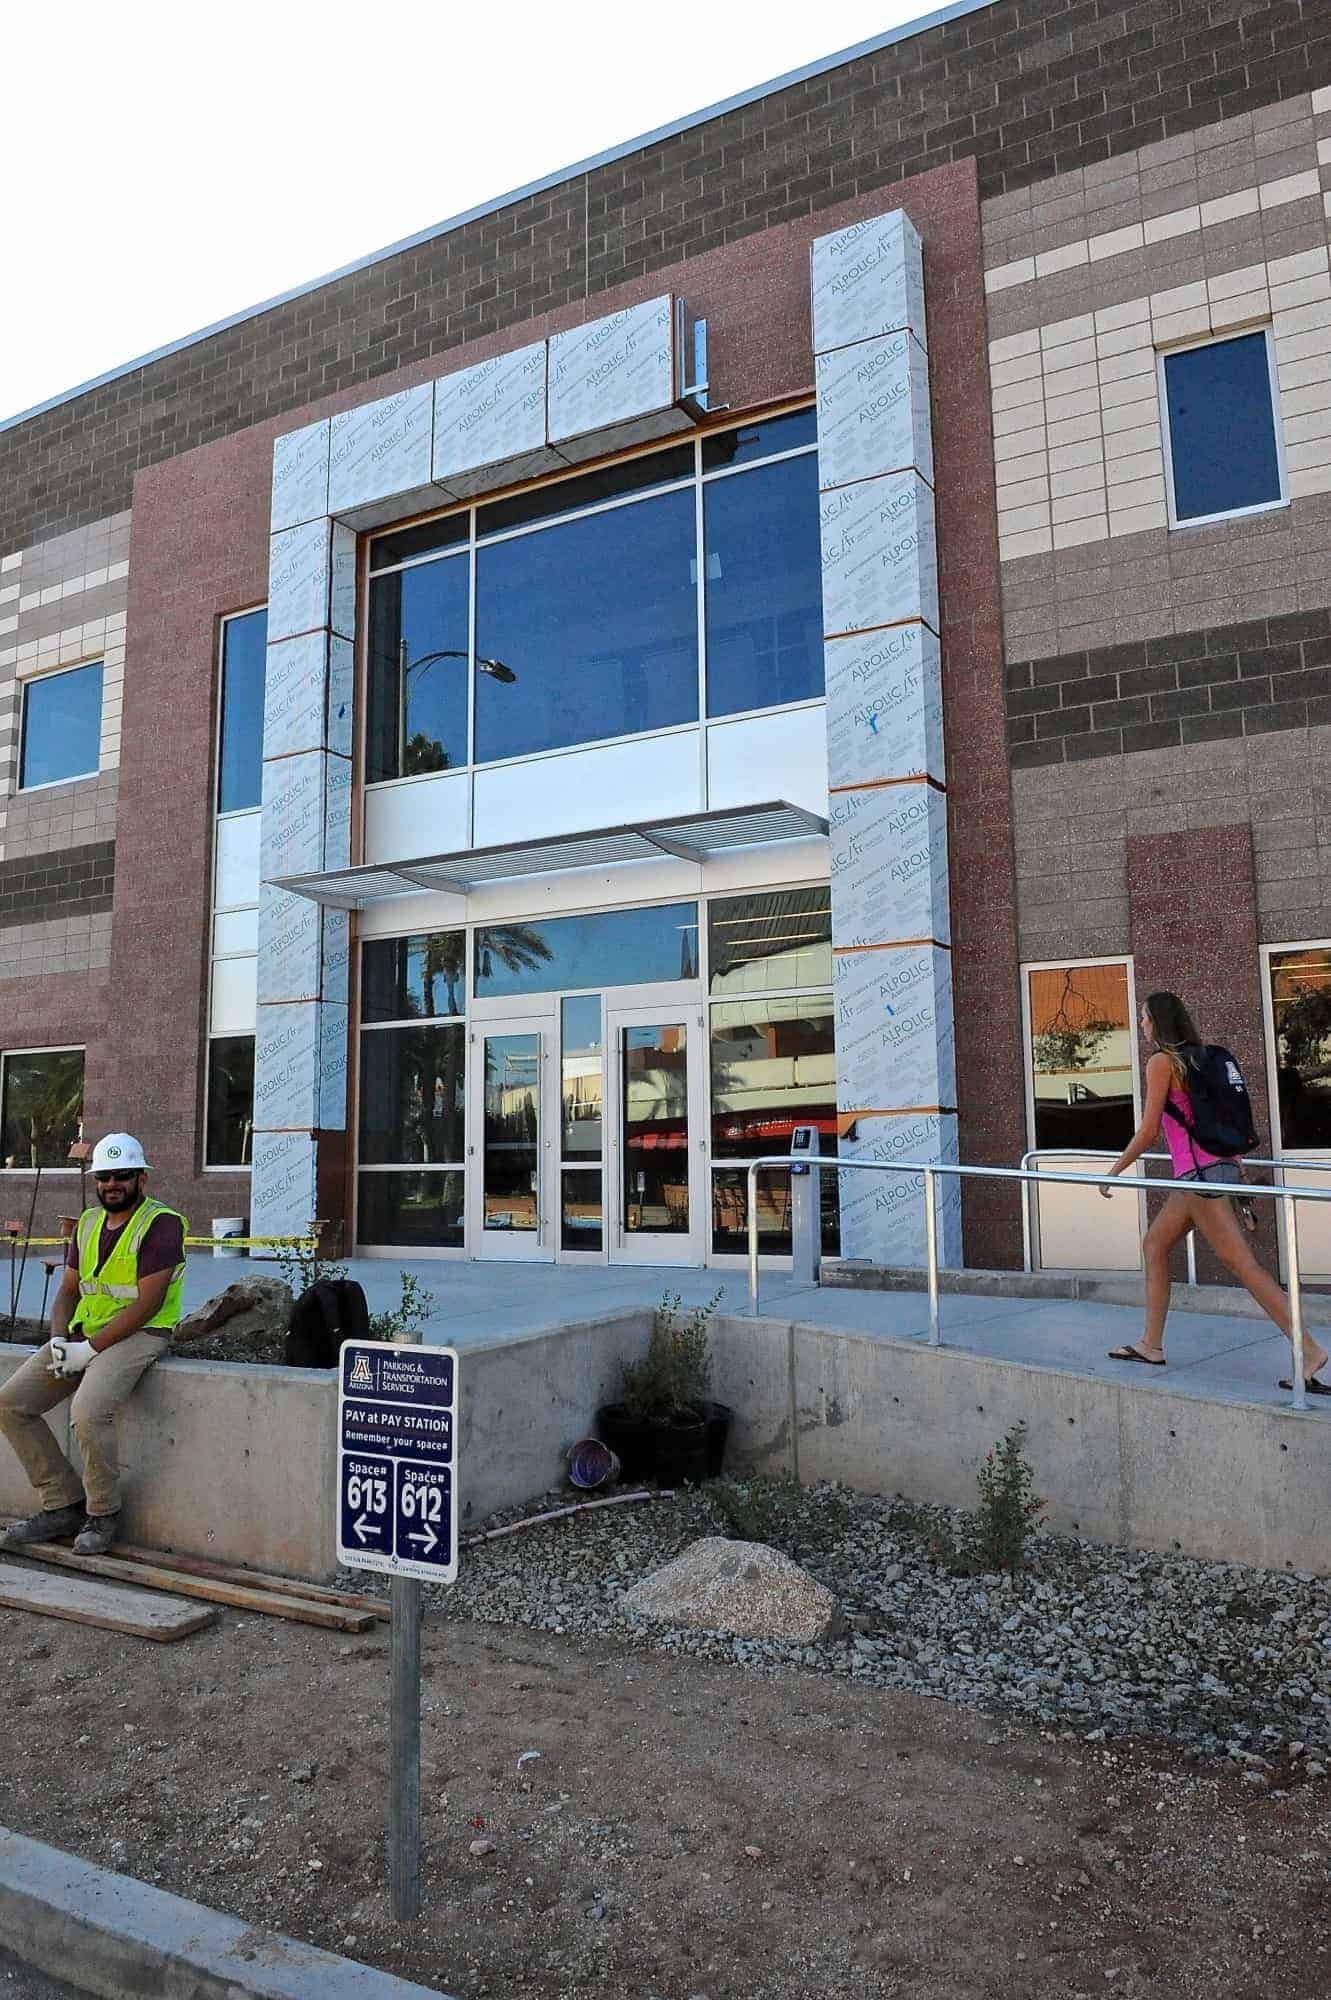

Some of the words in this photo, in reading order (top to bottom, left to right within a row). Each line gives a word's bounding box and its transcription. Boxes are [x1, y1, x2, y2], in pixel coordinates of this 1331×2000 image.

[383, 1361, 415, 1372] PARKING
[382, 1371, 448, 1386] TRANSPORTATION
[382, 1382, 415, 1393] SERVICES
[345, 1409, 365, 1422] PAY
[367, 1412, 378, 1424] at
[381, 1414, 402, 1428] PAY
[404, 1416, 449, 1432] STATION
[345, 1430, 390, 1444] Remember
[393, 1437, 413, 1447] your
[347, 1475, 387, 1514] 613
[401, 1482, 442, 1522] 612
